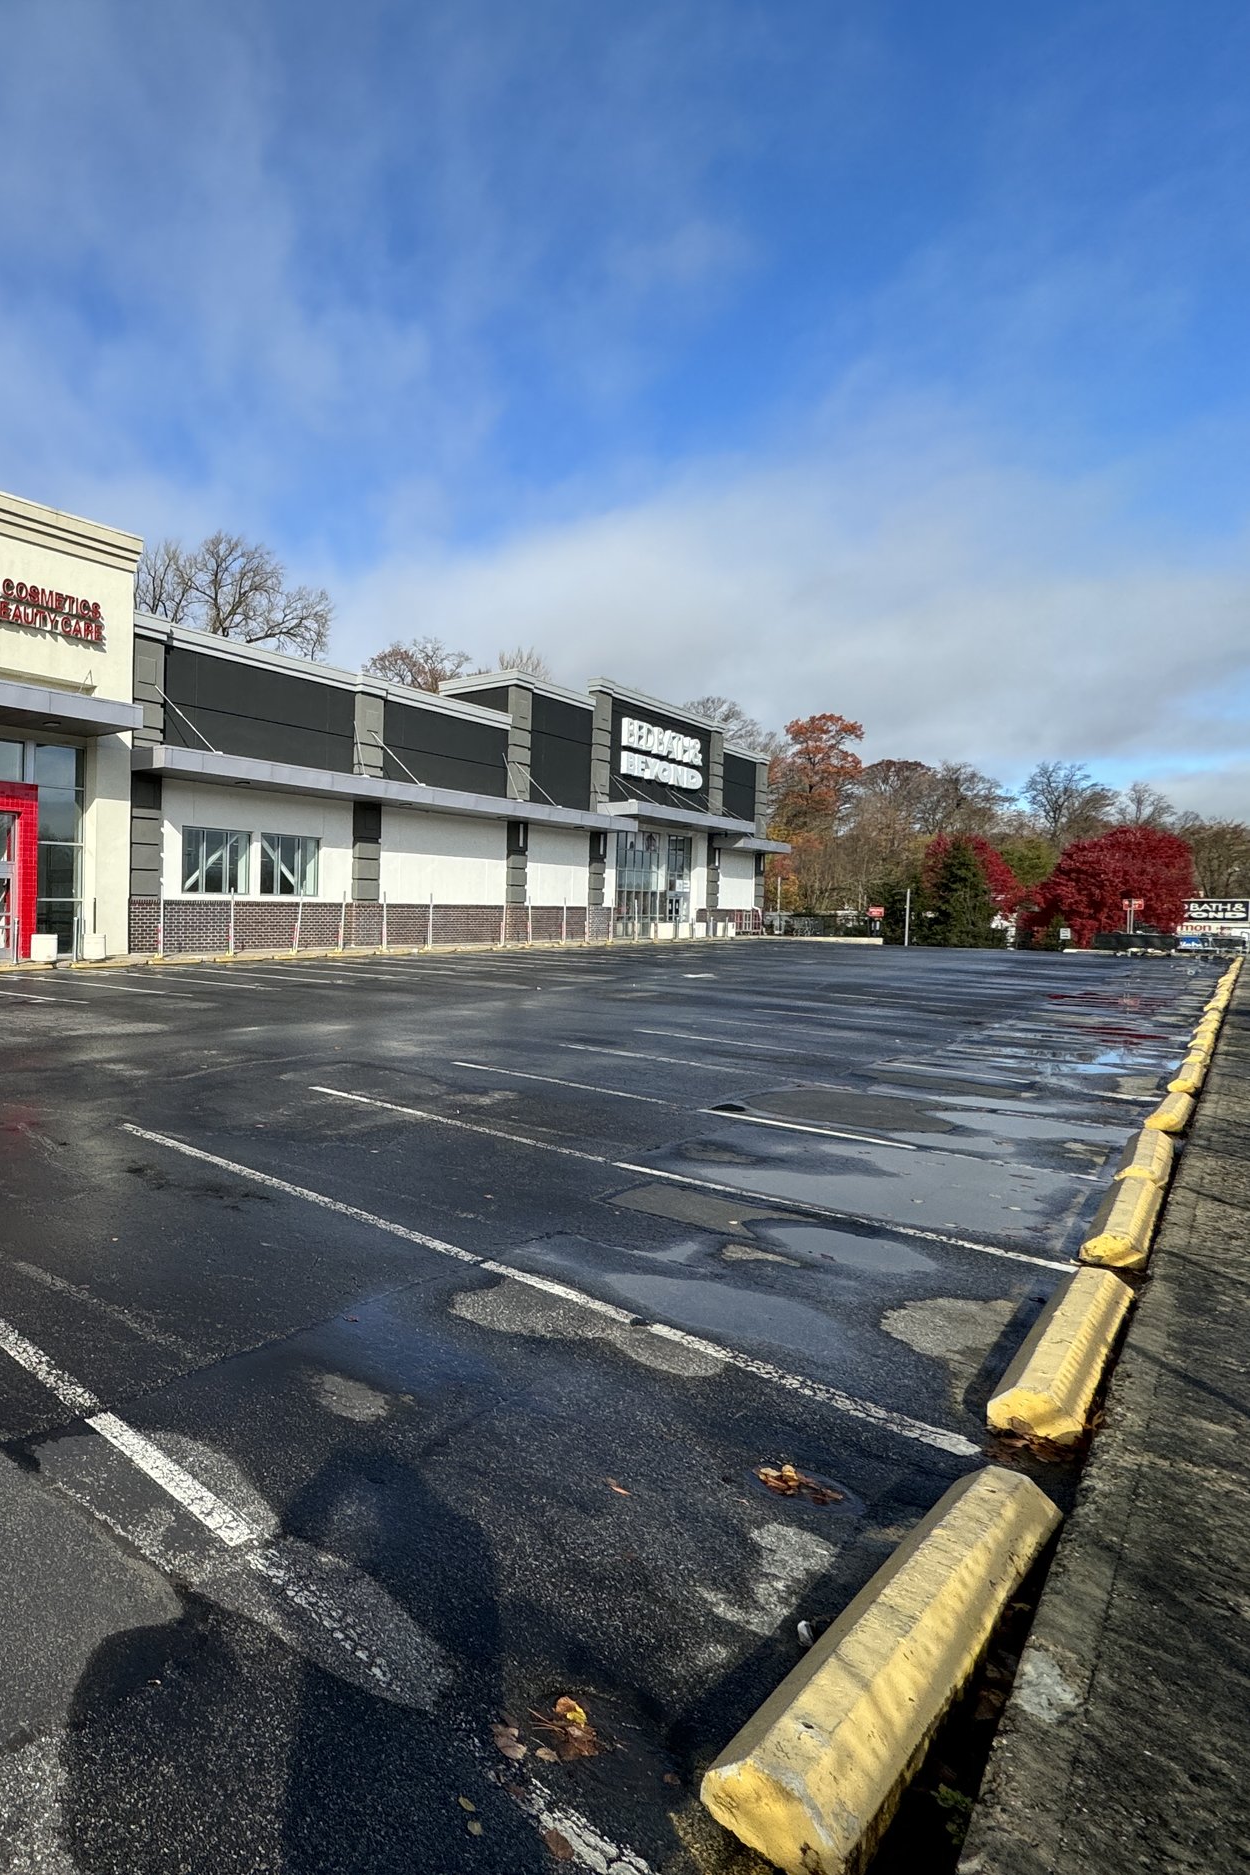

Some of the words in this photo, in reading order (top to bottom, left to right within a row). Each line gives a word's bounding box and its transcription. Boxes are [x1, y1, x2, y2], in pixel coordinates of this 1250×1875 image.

[1, 577, 102, 620] COSMETICS
[61, 615, 106, 642] CARE
[621, 717, 655, 752] BED
[651, 727, 691, 763] BATH
[689, 738, 703, 766] &
[620, 750, 703, 790] BEYOND
[1190, 903, 1231, 911] BATH
[1232, 903, 1246, 911] &
